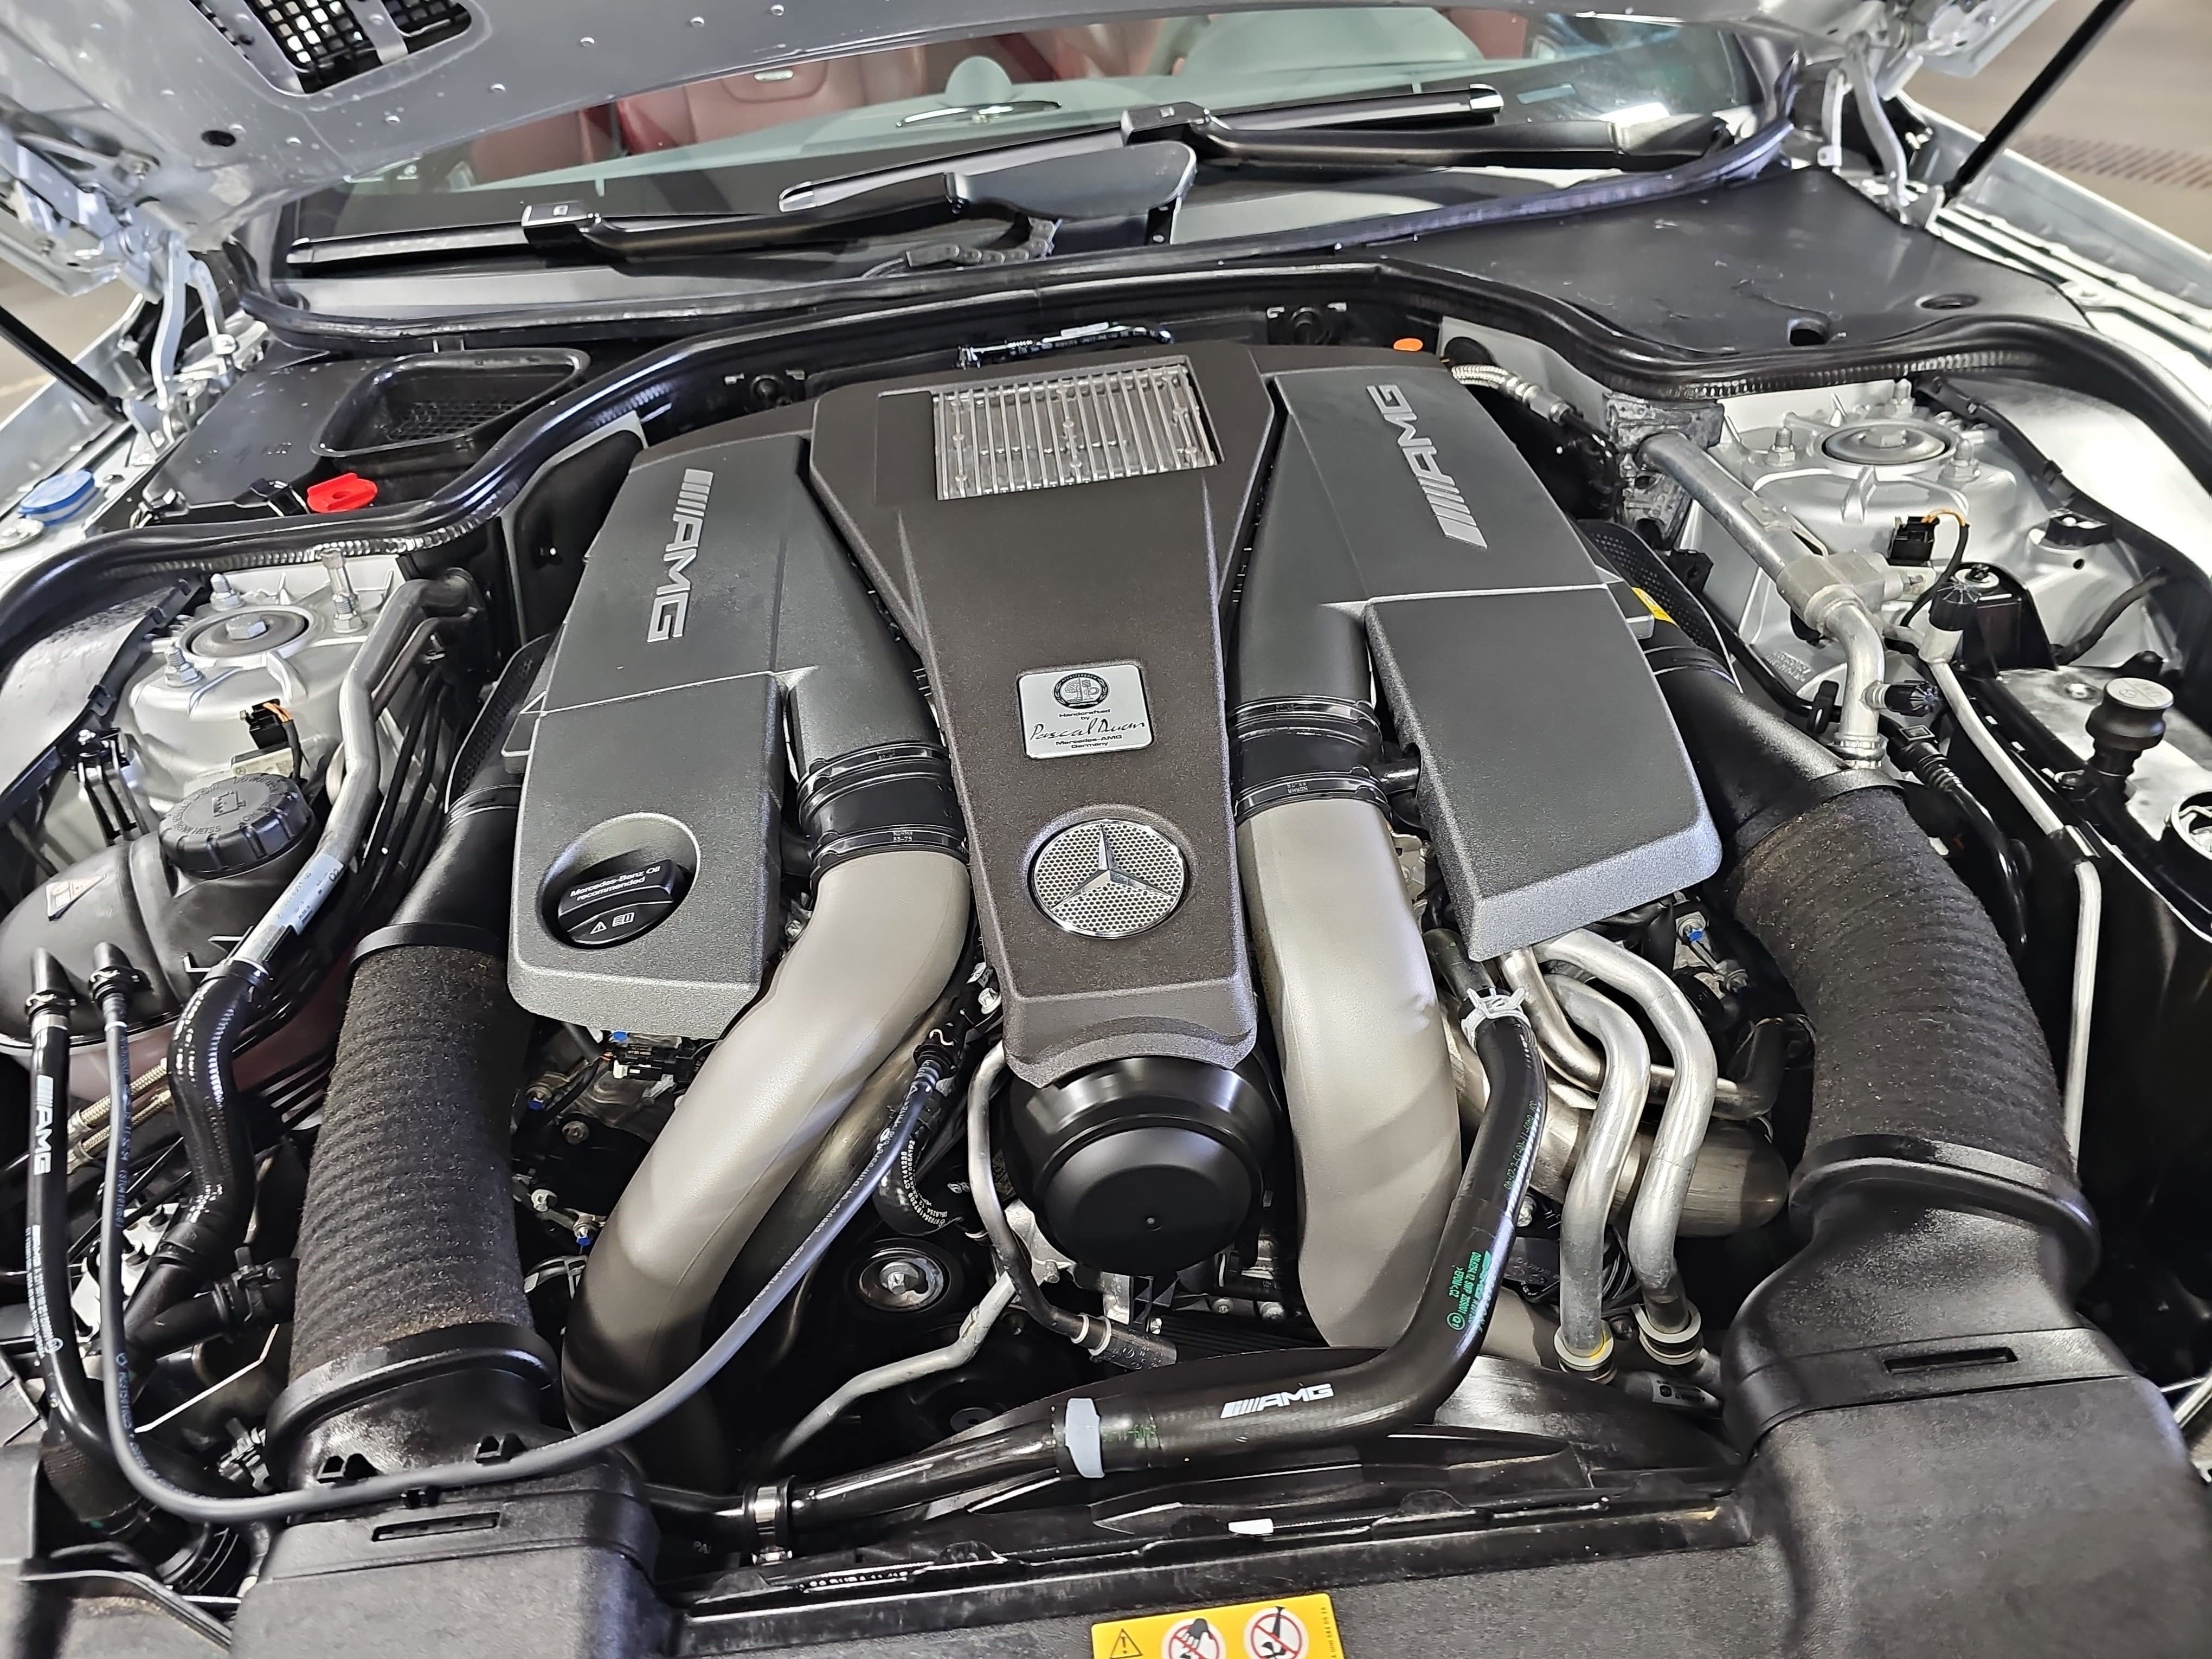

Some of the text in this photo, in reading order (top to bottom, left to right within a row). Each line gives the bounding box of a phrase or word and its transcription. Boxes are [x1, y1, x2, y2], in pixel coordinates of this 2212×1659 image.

[647, 512, 703, 642] AMG
[1059, 709, 1111, 718] Handcrafted
[1056, 735, 1122, 745] Mercedes-AMG
[570, 866, 660, 897] Mercedes-Benz Oil
[576, 876, 646, 901] recommended
[34, 1105, 53, 1176] AMG
[1256, 1383, 1334, 1412] AMG
